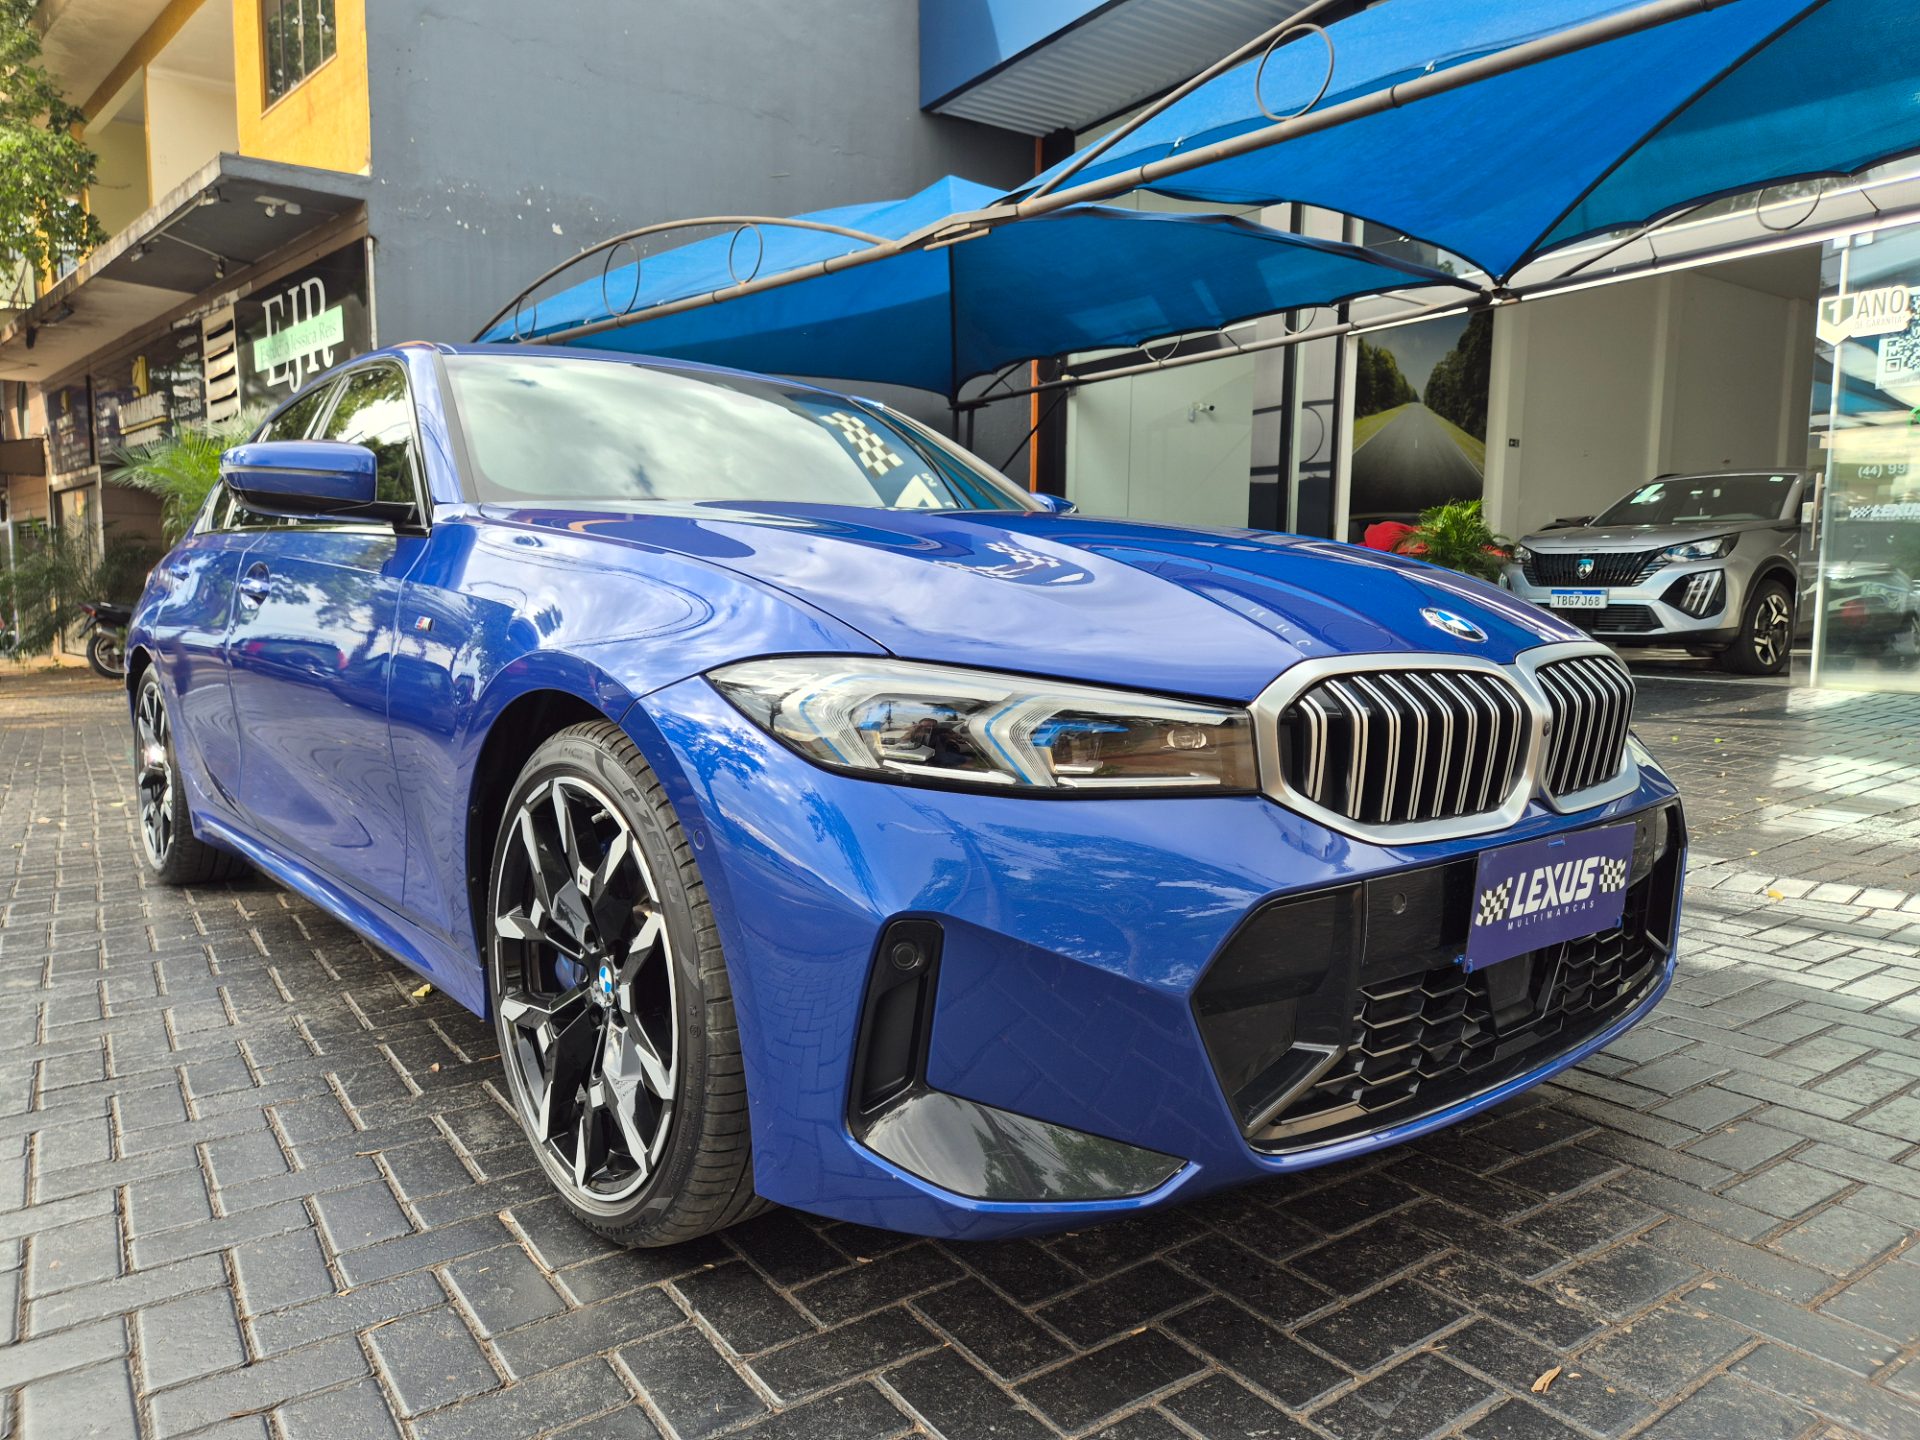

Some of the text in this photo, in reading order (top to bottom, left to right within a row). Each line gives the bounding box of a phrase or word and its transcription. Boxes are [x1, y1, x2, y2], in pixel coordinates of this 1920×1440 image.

[1829, 289, 1904, 324] 1 ANO
[262, 277, 334, 393] EJR
[1858, 465, 1882, 478] (44)
[1556, 596, 1600, 606] TBG7J68
[1509, 856, 1600, 919] LEXUS
[1507, 900, 1595, 931] MULTIMARCAS
